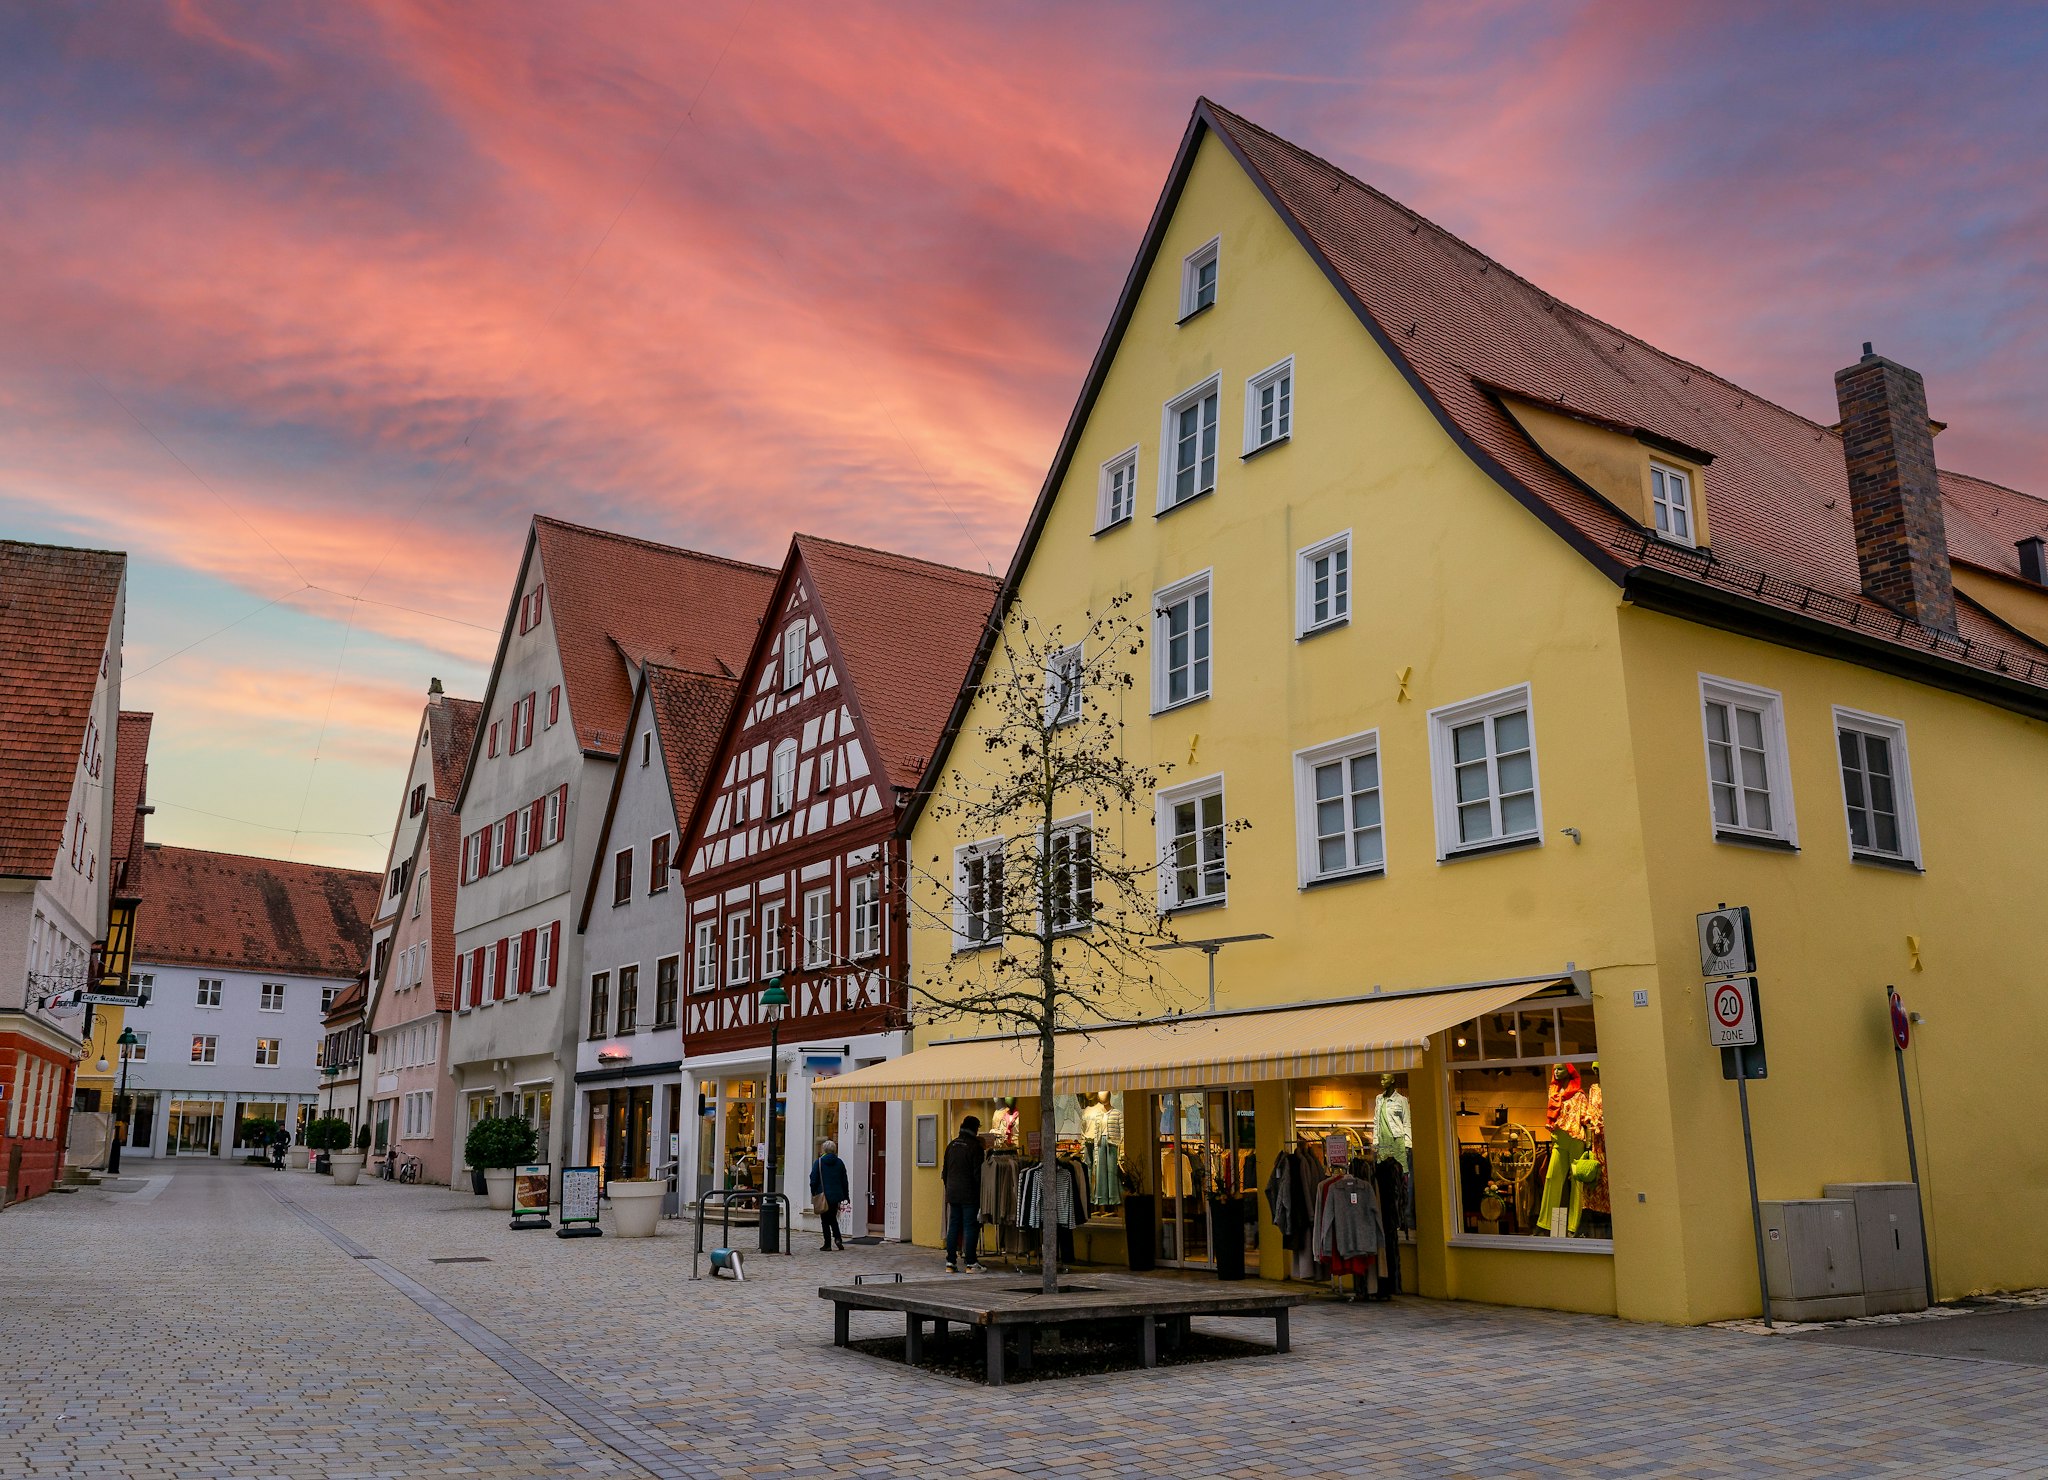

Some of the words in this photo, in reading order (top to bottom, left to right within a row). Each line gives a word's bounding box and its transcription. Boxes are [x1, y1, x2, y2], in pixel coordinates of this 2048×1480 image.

[1713, 959, 1735, 971] ZONE
[100, 995, 137, 1004] Restaurant
[1721, 996, 1738, 1016] 20
[1721, 1030, 1744, 1041] ZONE
